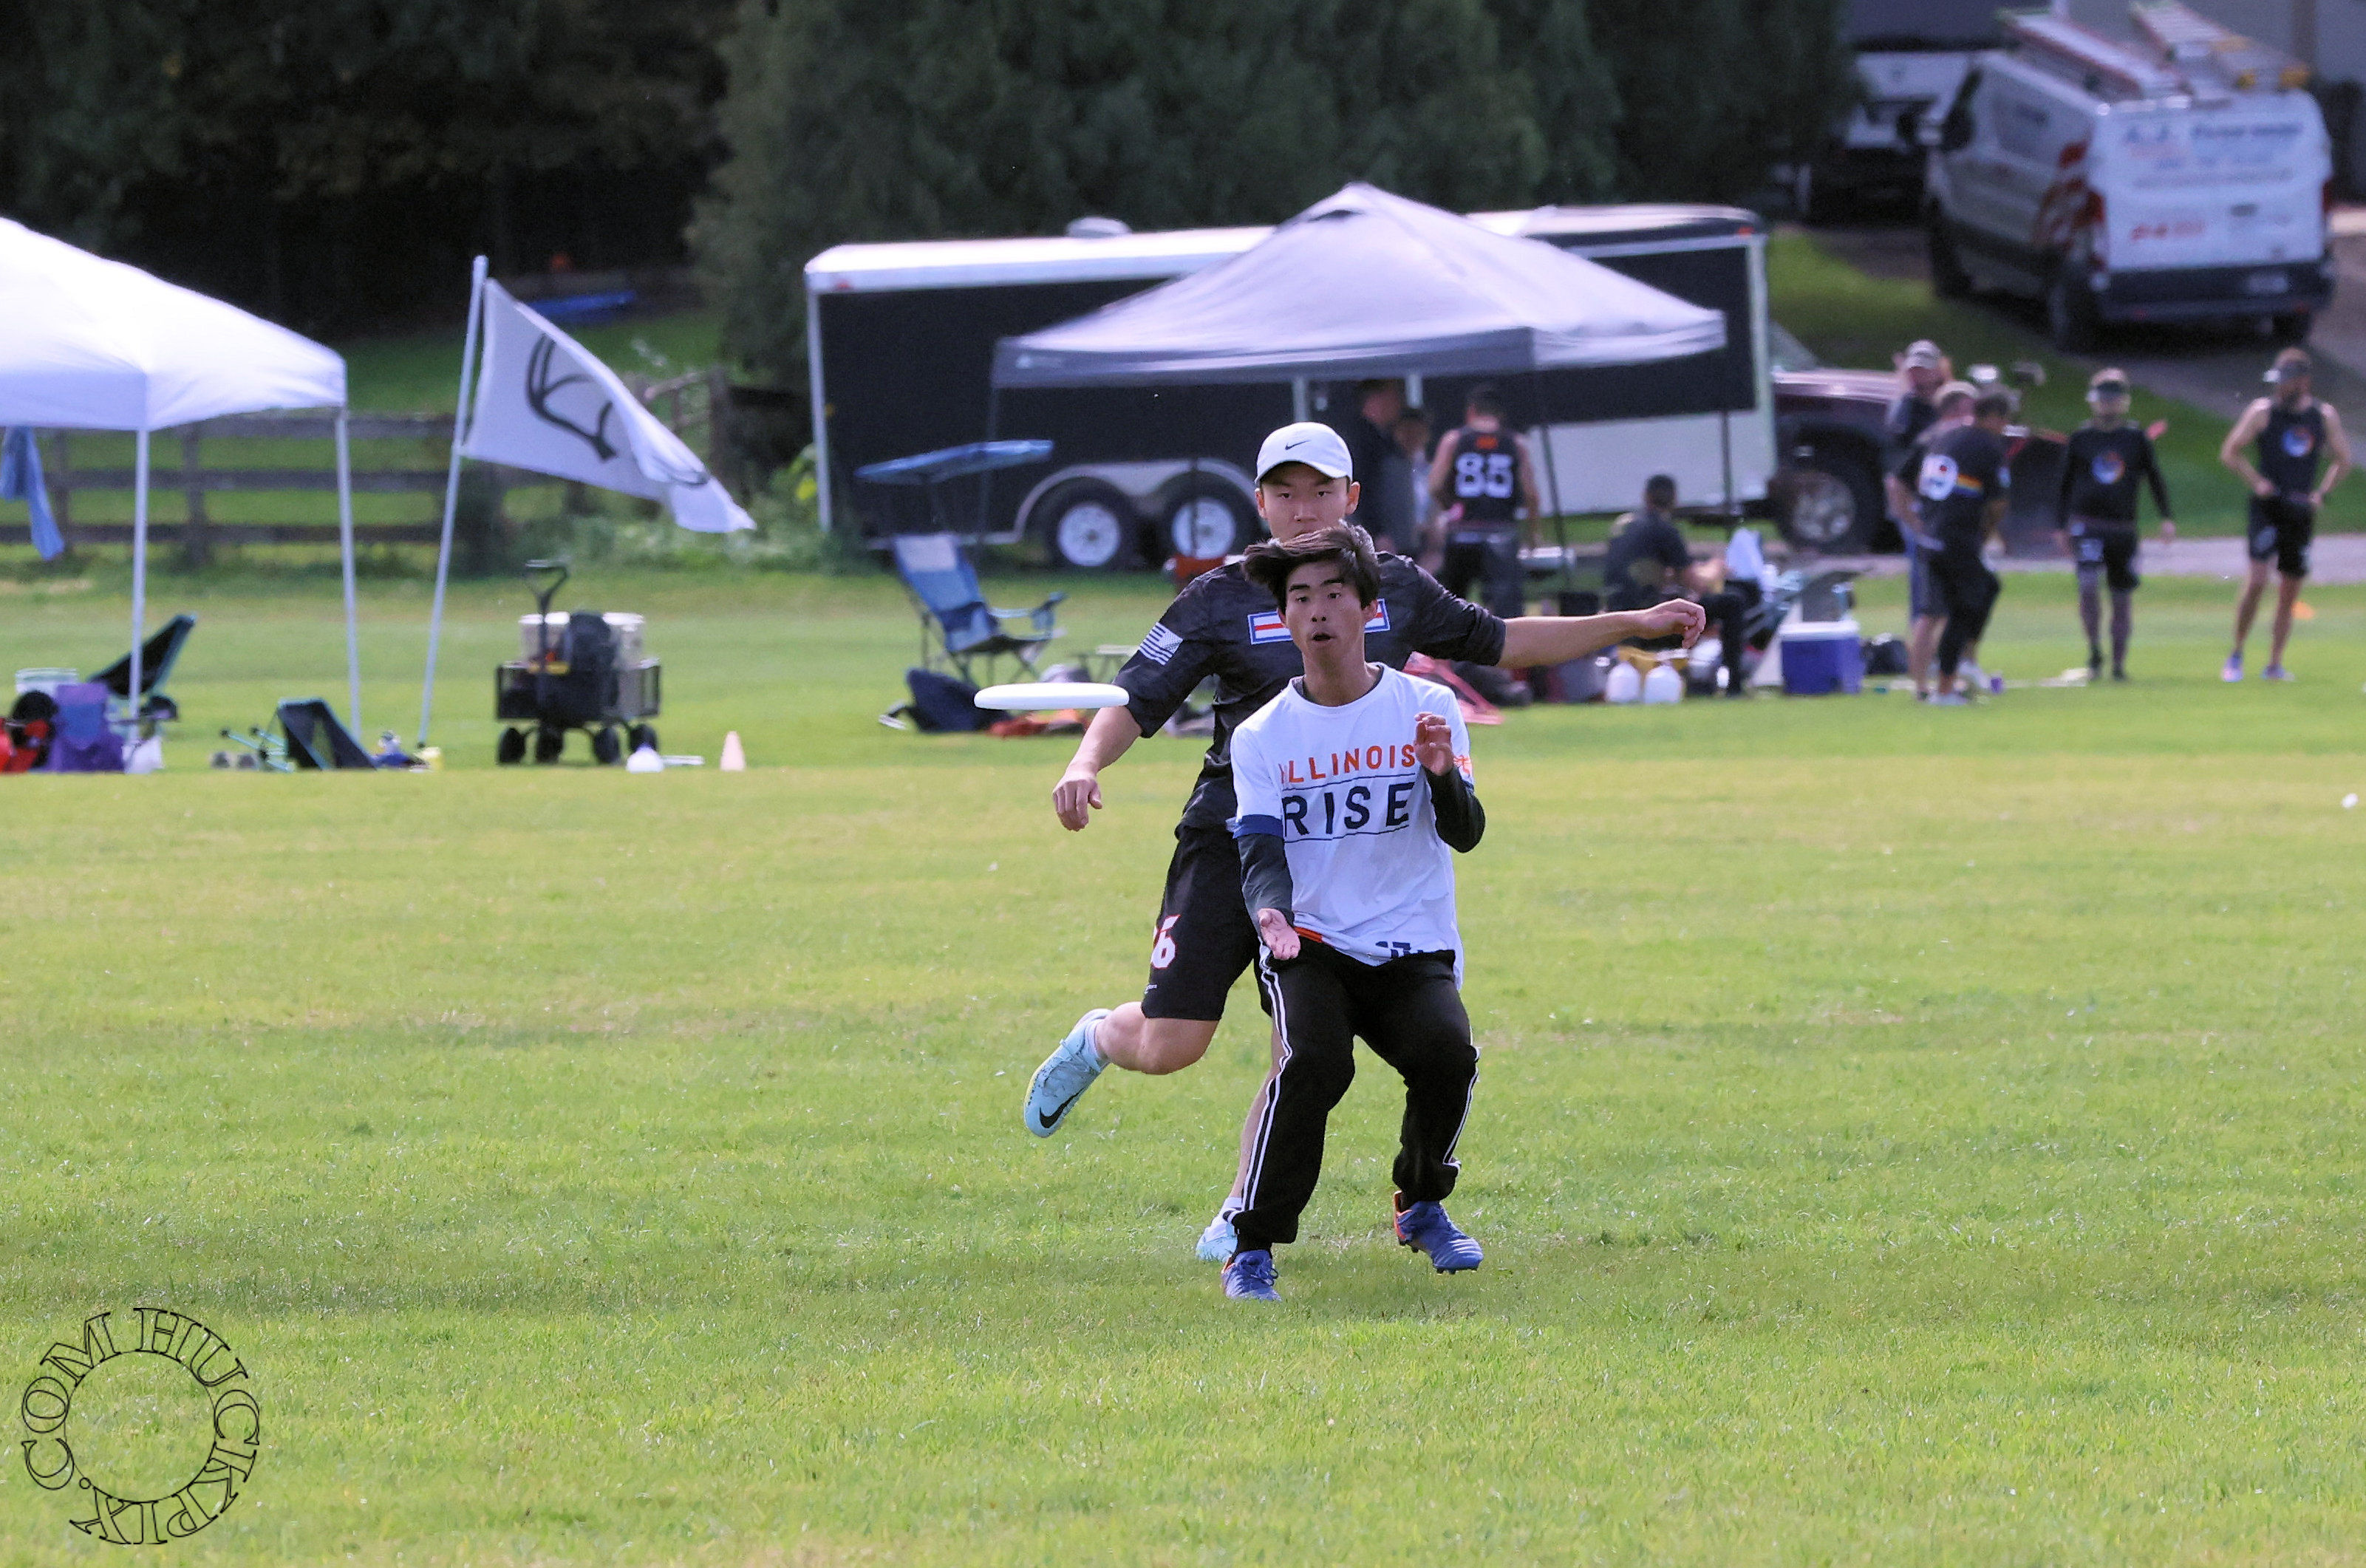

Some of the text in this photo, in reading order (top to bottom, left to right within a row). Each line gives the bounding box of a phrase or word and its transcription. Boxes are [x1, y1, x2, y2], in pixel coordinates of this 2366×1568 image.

[1455, 452, 1513, 499] 85
[1278, 744, 1416, 784] ILLINOIS
[1282, 782, 1415, 837] RISE
[1150, 914, 1181, 969] 6
